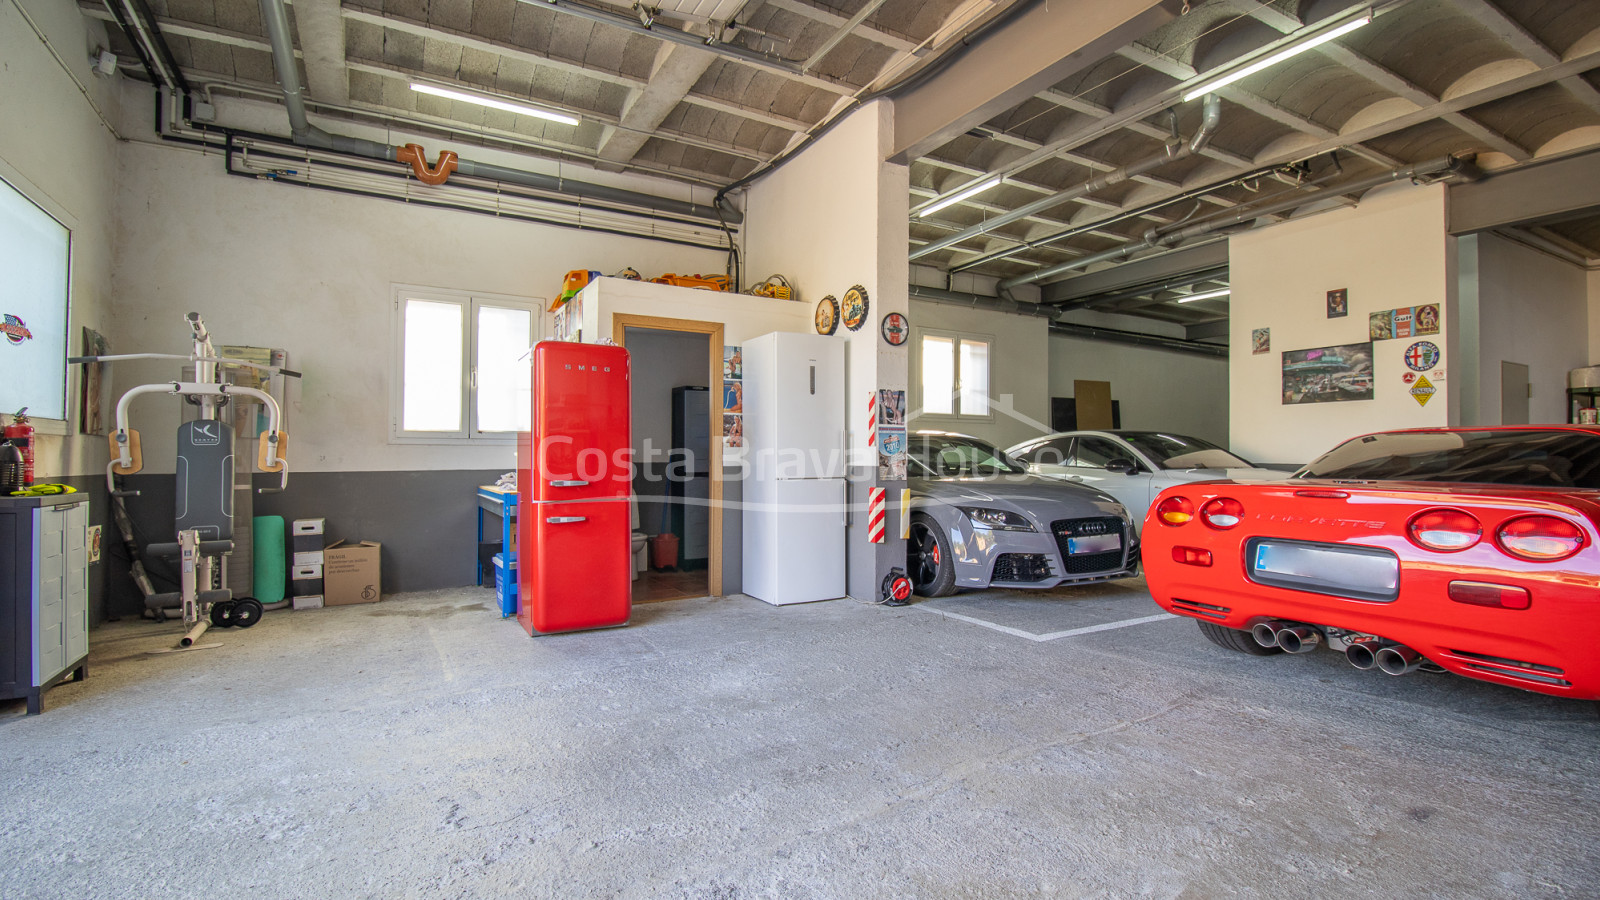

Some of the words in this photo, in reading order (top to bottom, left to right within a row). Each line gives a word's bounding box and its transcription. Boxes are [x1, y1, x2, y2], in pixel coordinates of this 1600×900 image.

[1394, 314, 1412, 322] Gulf
[1418, 341, 1438, 353] ROMEO
[565, 364, 611, 372] SMEG
